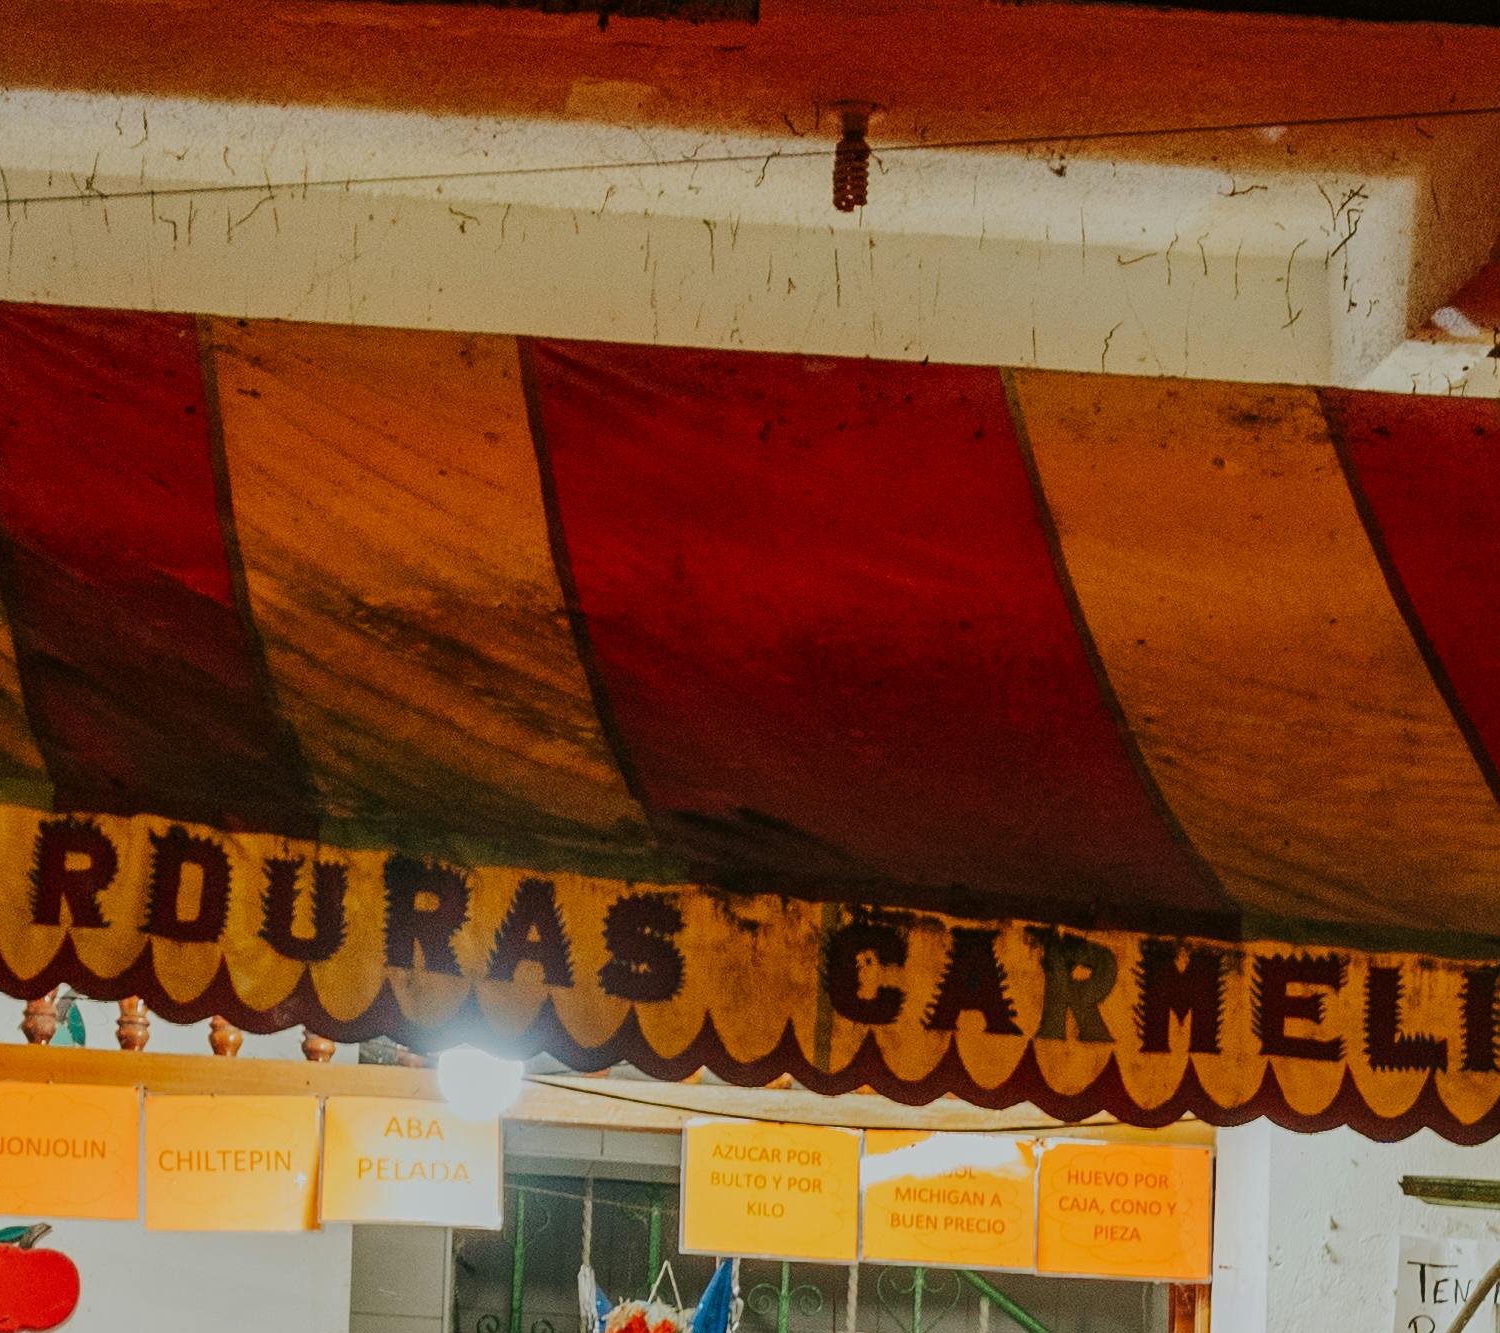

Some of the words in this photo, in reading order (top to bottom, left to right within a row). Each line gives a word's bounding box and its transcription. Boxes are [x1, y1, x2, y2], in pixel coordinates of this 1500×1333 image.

[384, 1115, 445, 1141] ABA
[158, 1149, 292, 1172] CHILTEPIN
[711, 1143, 781, 1164] AZUCAR
[787, 1150, 822, 1166] POR
[710, 1171, 767, 1190] BULTO
[772, 1175, 784, 1190] Y
[788, 1177, 822, 1193] POR
[1067, 1169, 1129, 1188] HUEVO
[1133, 1173, 1169, 1189] POR
[894, 1186, 985, 1206] MICHIGAN
[990, 1191, 1002, 1207] A
[1058, 1195, 1105, 1216] CAJA,
[1110, 1199, 1162, 1217] CONO
[1166, 1201, 1177, 1217] Y
[746, 1201, 785, 1219] KILO
[890, 1213, 938, 1231] BUEN
[943, 1216, 1005, 1235] PRECIO
[1094, 1224, 1142, 1242] PIEZA
